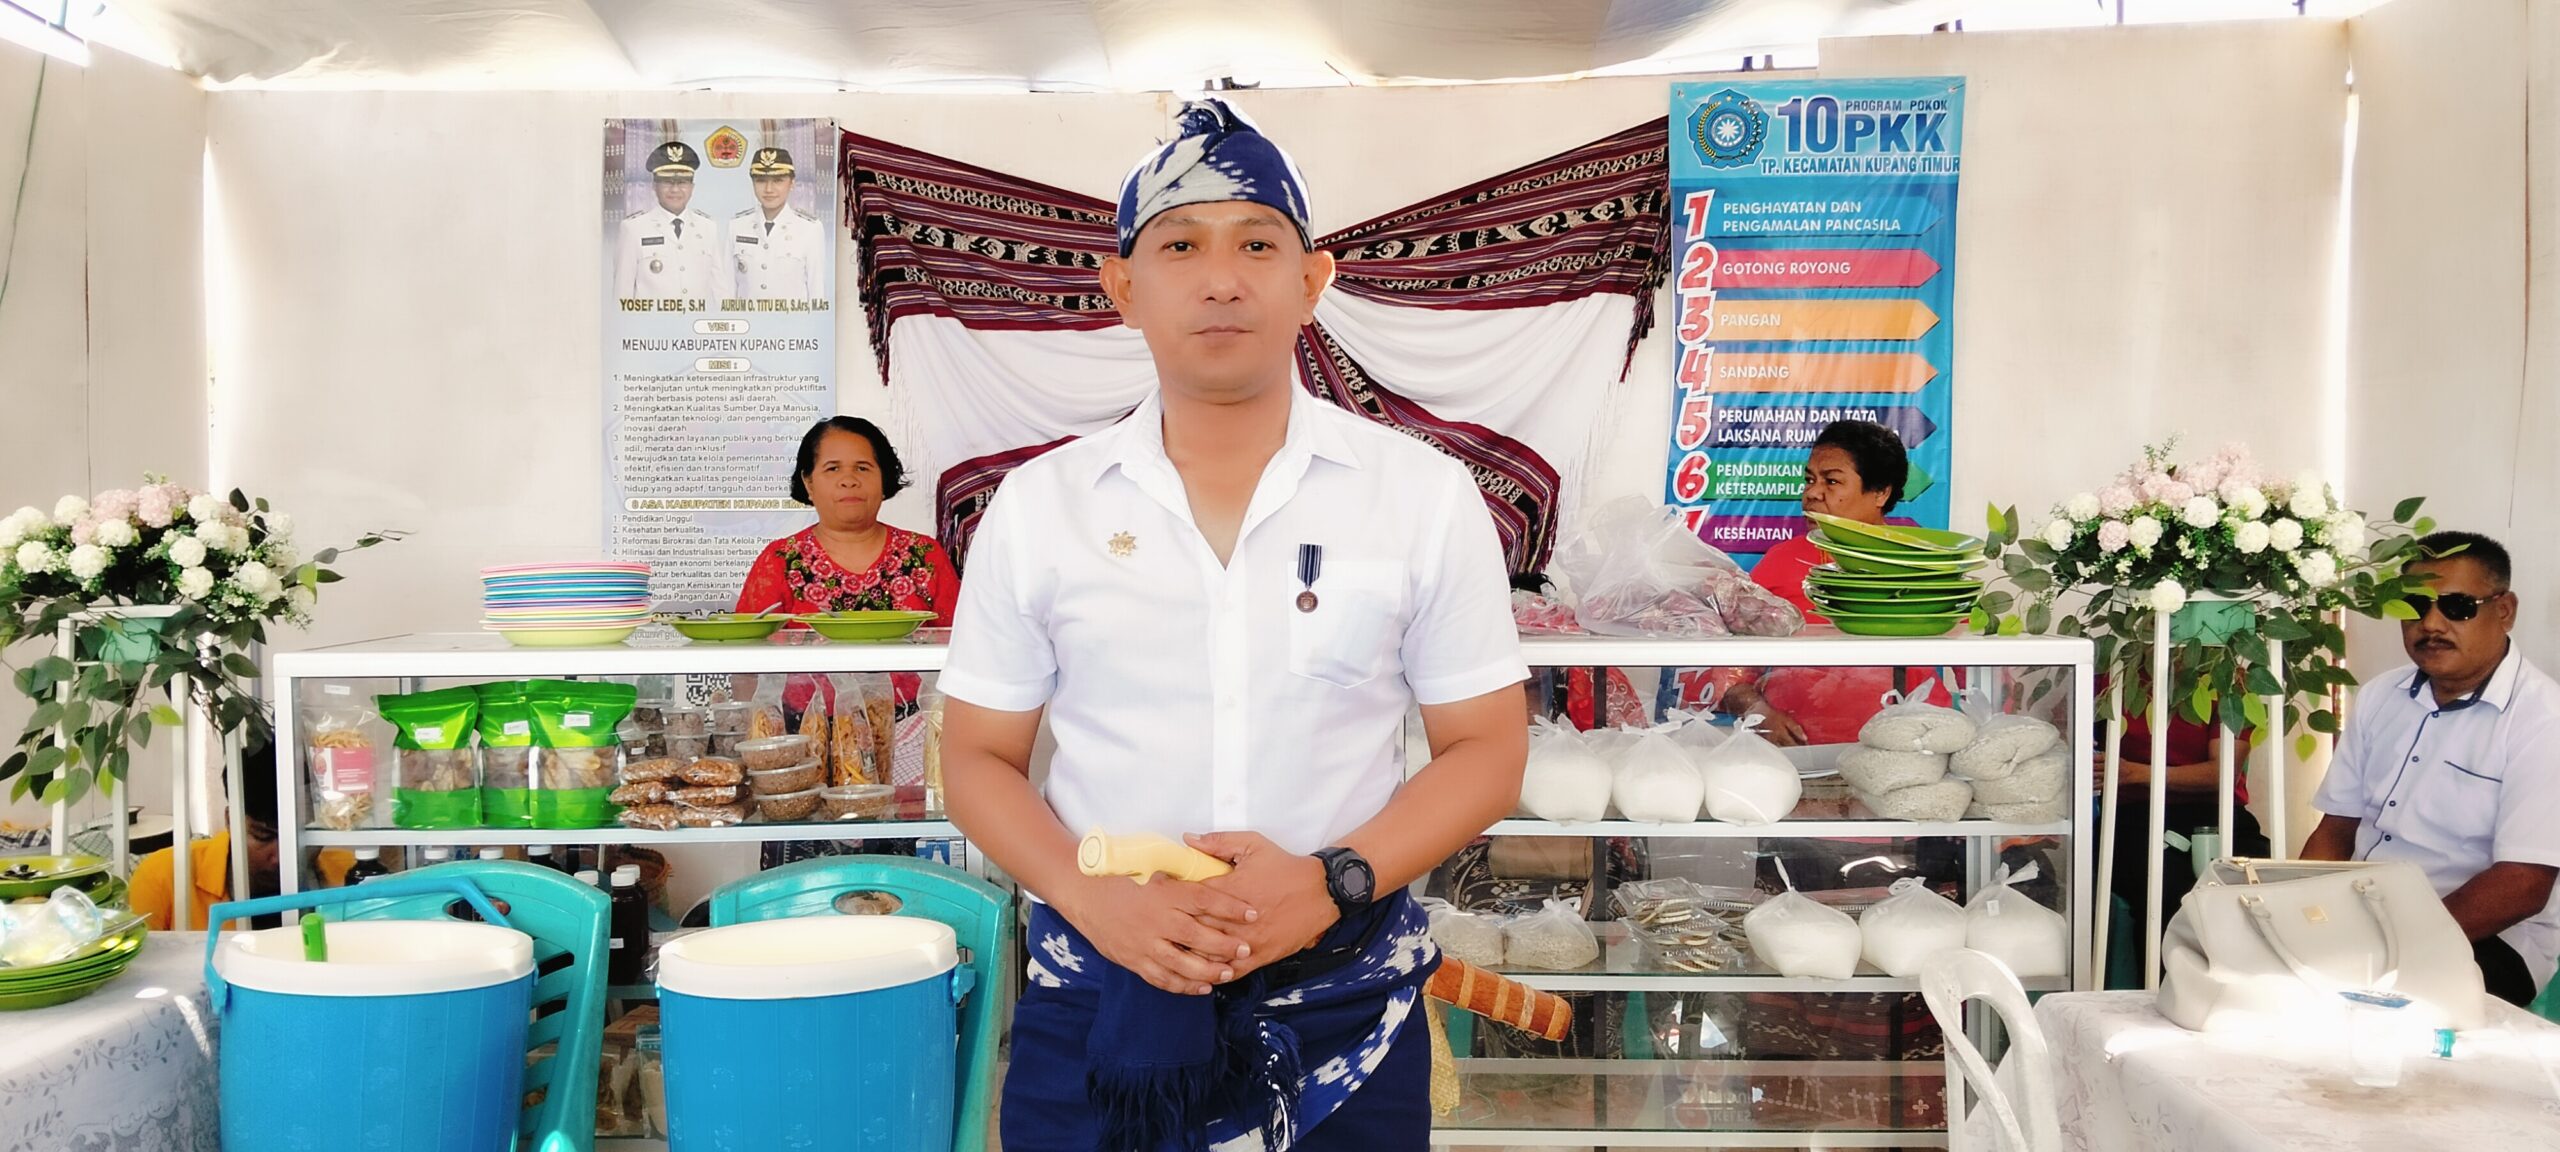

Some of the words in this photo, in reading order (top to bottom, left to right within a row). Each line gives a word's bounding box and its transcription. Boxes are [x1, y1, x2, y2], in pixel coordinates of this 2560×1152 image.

[1846, 99, 1902, 112] PROGRAM
[1910, 99, 1948, 111] POKOK
[1776, 95, 1840, 154] 10
[1844, 113, 1949, 153] PKK
[1761, 158, 1781, 174] TP.
[1784, 157, 1861, 174] KECAMATAN
[1865, 156, 1917, 172] KUPANG
[1921, 156, 1960, 171] TIMUR
[1723, 202, 1826, 215] PENGHAYATAN
[1830, 201, 1862, 213] DAN
[1683, 189, 1715, 243] 1
[1723, 219, 1824, 232] PENGAMALAN
[1826, 218, 1900, 231] PANCASILA
[1678, 243, 1718, 294] 2
[1722, 262, 1785, 275] GOTONG
[1789, 261, 1851, 274] ROYONG
[619, 299, 654, 312] YOSEF
[657, 299, 686, 314] LEDE,
[689, 299, 706, 311] S.H
[720, 299, 746, 311] AURUM
[757, 299, 774, 311] TITU
[775, 299, 789, 314] EKI,
[1678, 291, 1716, 345] 3
[1720, 314, 1781, 327] PANGAN
[708, 322, 730, 331] VISI
[622, 339, 668, 351] MENUJU
[672, 339, 736, 351] KABUPATEN
[740, 339, 785, 351] KUPANG
[789, 339, 819, 351] EMAS
[1676, 344, 1714, 396] 4
[1719, 366, 1789, 379] SANDANG
[624, 374, 684, 383] Meningkatkan
[686, 374, 741, 382] ketersediaan
[743, 374, 796, 382] infrastruktur
[799, 375, 819, 383] yang
[624, 385, 683, 393] berkelanjutan
[712, 385, 772, 393] meningkatkan
[624, 394, 654, 402] daerah
[657, 394, 693, 402] berbasis
[696, 394, 727, 403] potensi
[729, 394, 744, 402] asli
[624, 404, 684, 413] Meningkatkan
[687, 404, 721, 412] Kualitas
[724, 404, 756, 412] Sumber
[759, 404, 781, 413] Daya
[624, 414, 680, 422] Pemanfaatan
[727, 414, 743, 422] dan
[745, 414, 812, 423] pengembangan
[1719, 409, 1807, 423] PERUMAHAN
[1810, 409, 1841, 423] DAN
[1845, 409, 1877, 422] TATA
[624, 424, 655, 432] inovasi
[657, 424, 687, 432] daerah
[1676, 397, 1713, 451] 5
[624, 434, 684, 443] Menghadirkan
[687, 434, 721, 443] layanan
[723, 434, 748, 443] publik
[751, 435, 773, 443] yang
[1718, 429, 1781, 443] LAKSANA
[676, 444, 692, 452] dan
[694, 444, 726, 452] inklusif
[624, 454, 678, 463] Mewujudkan
[698, 454, 724, 462] kelola
[726, 454, 785, 463] pemerintahan
[656, 464, 684, 472] efisien
[686, 464, 702, 472] dan
[704, 464, 760, 472] transformatif
[1716, 464, 1802, 477] PENDIDIKAN
[624, 474, 684, 483] Meningkatkan
[686, 474, 720, 482] kualitas
[722, 474, 774, 483] pengelolaan
[1673, 451, 1712, 503] 6
[624, 484, 649, 493] hidup
[651, 485, 672, 493] yang
[708, 485, 744, 493] tangguh
[746, 484, 762, 492] dan
[1715, 483, 1805, 496] KETERAMPILA
[640, 499, 665, 510] ASA
[665, 499, 732, 510] KABUPATEN
[733, 499, 780, 510] KUPANG
[622, 515, 664, 523] Pendidikan
[666, 515, 693, 524] Unggul
[622, 526, 662, 534] Kesehatan
[664, 526, 704, 534] berkualitas
[1714, 527, 1794, 540] KESEHATAN
[622, 537, 661, 545] Reformasi
[663, 537, 696, 545] Birokrasi
[698, 537, 712, 545] dan
[714, 537, 730, 545] Tata
[732, 537, 755, 545] Kelola
[657, 548, 671, 556] dan
[673, 548, 725, 556] Industrialisasi
[727, 548, 759, 556] berbasis
[671, 570, 712, 578] berkualitas
[713, 570, 728, 578] dan
[687, 581, 731, 589] Kemiskinan
[674, 592, 702, 601] Pangan
[704, 592, 718, 600] dan
[719, 592, 731, 600] Air
